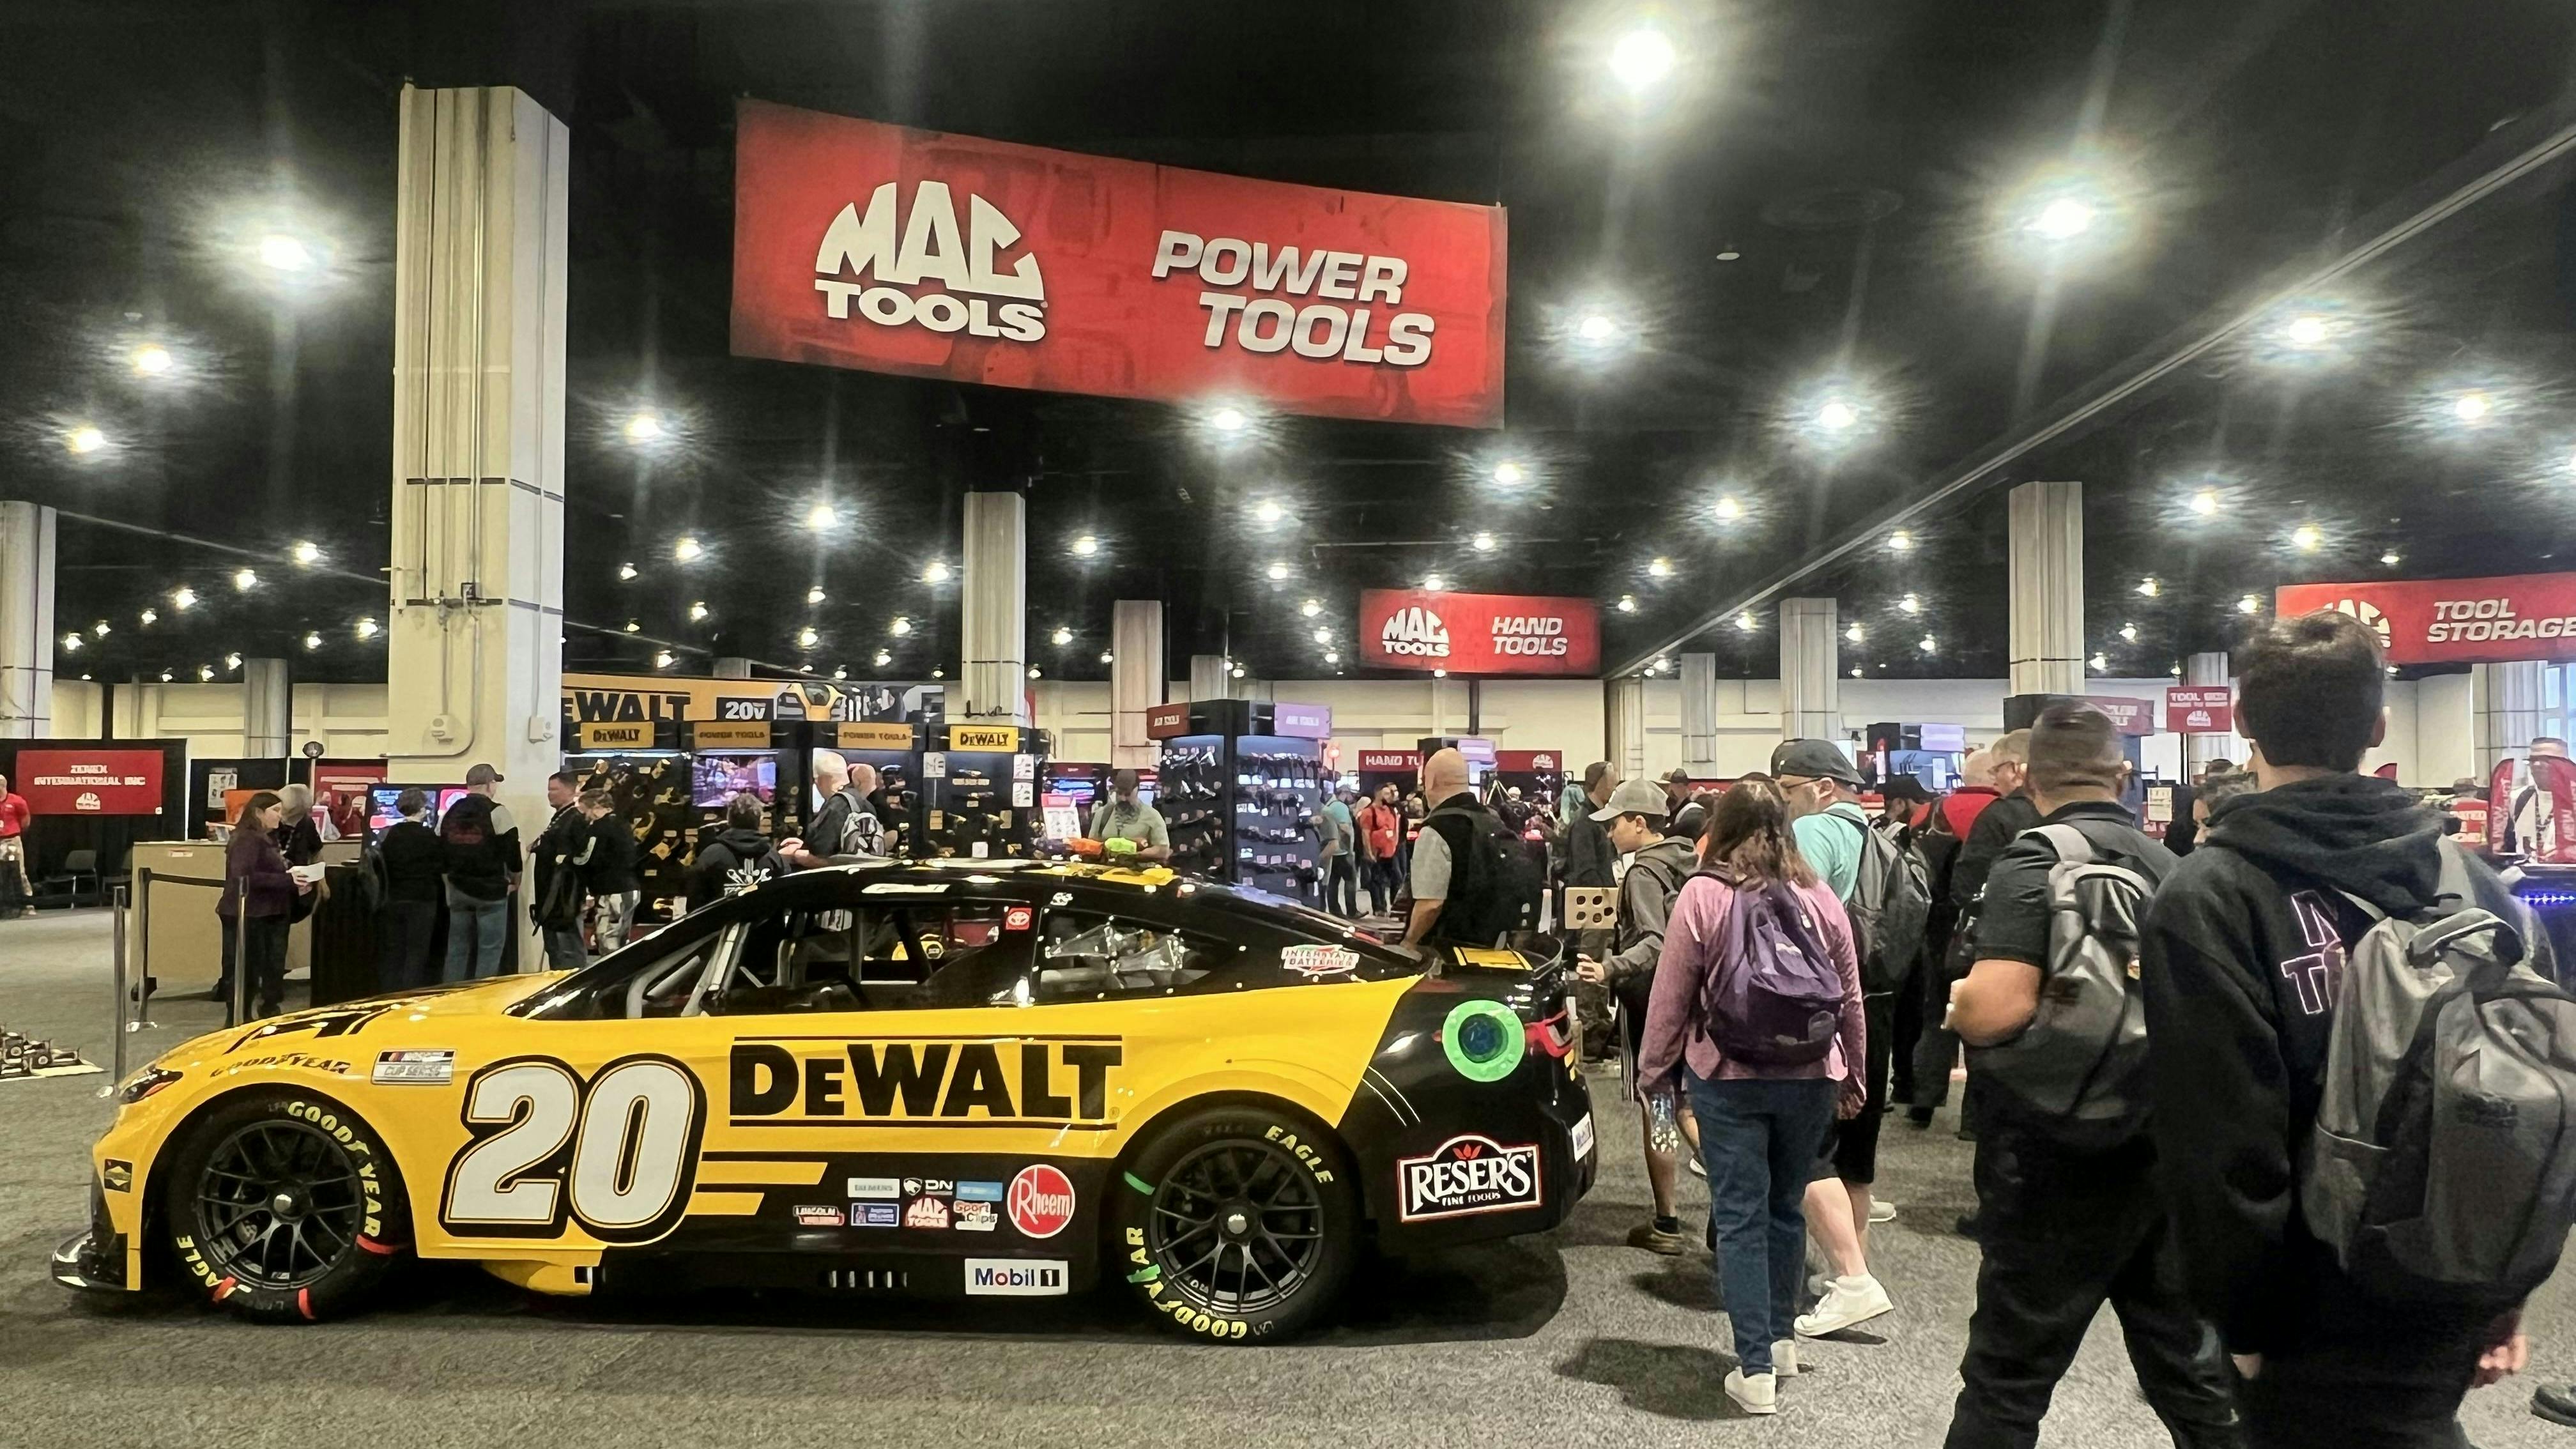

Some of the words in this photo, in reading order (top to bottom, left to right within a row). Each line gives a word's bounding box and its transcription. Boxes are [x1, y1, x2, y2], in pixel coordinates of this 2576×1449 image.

[815, 180, 1045, 300] MAC
[1151, 229, 1408, 305] POWER
[815, 279, 1046, 342] TOOLS
[1199, 291, 1436, 366] TOOLS
[2434, 599, 2516, 620] TOOL
[1383, 607, 1449, 644] MAC
[1492, 617, 1563, 636] HAND
[2428, 617, 2576, 643] STORAGE
[1382, 640, 1450, 657] TOOLS
[1492, 637, 1568, 656] TOOLS
[561, 691, 691, 721] EWALT
[960, 732, 1009, 746] DEWALT
[1366, 755, 1403, 766] HAND
[210, 1052, 351, 1078] GOODYEAR
[730, 1043, 1122, 1119] DEWALT
[442, 1057, 700, 1234] 20
[1264, 1125, 1334, 1183] EAGLE
[287, 1100, 383, 1238] GOODYEAR
[1411, 1152, 1531, 1213] RESER'S
[925, 1179, 953, 1190] DN
[1015, 1167, 1071, 1225] Rheem
[1442, 1196, 1464, 1206] FINE
[1468, 1190, 1501, 1203] FOODS
[907, 1197, 948, 1218] MAC
[975, 1268, 1034, 1287] Mobil
[1126, 1227, 1247, 1338] GOODYAR
